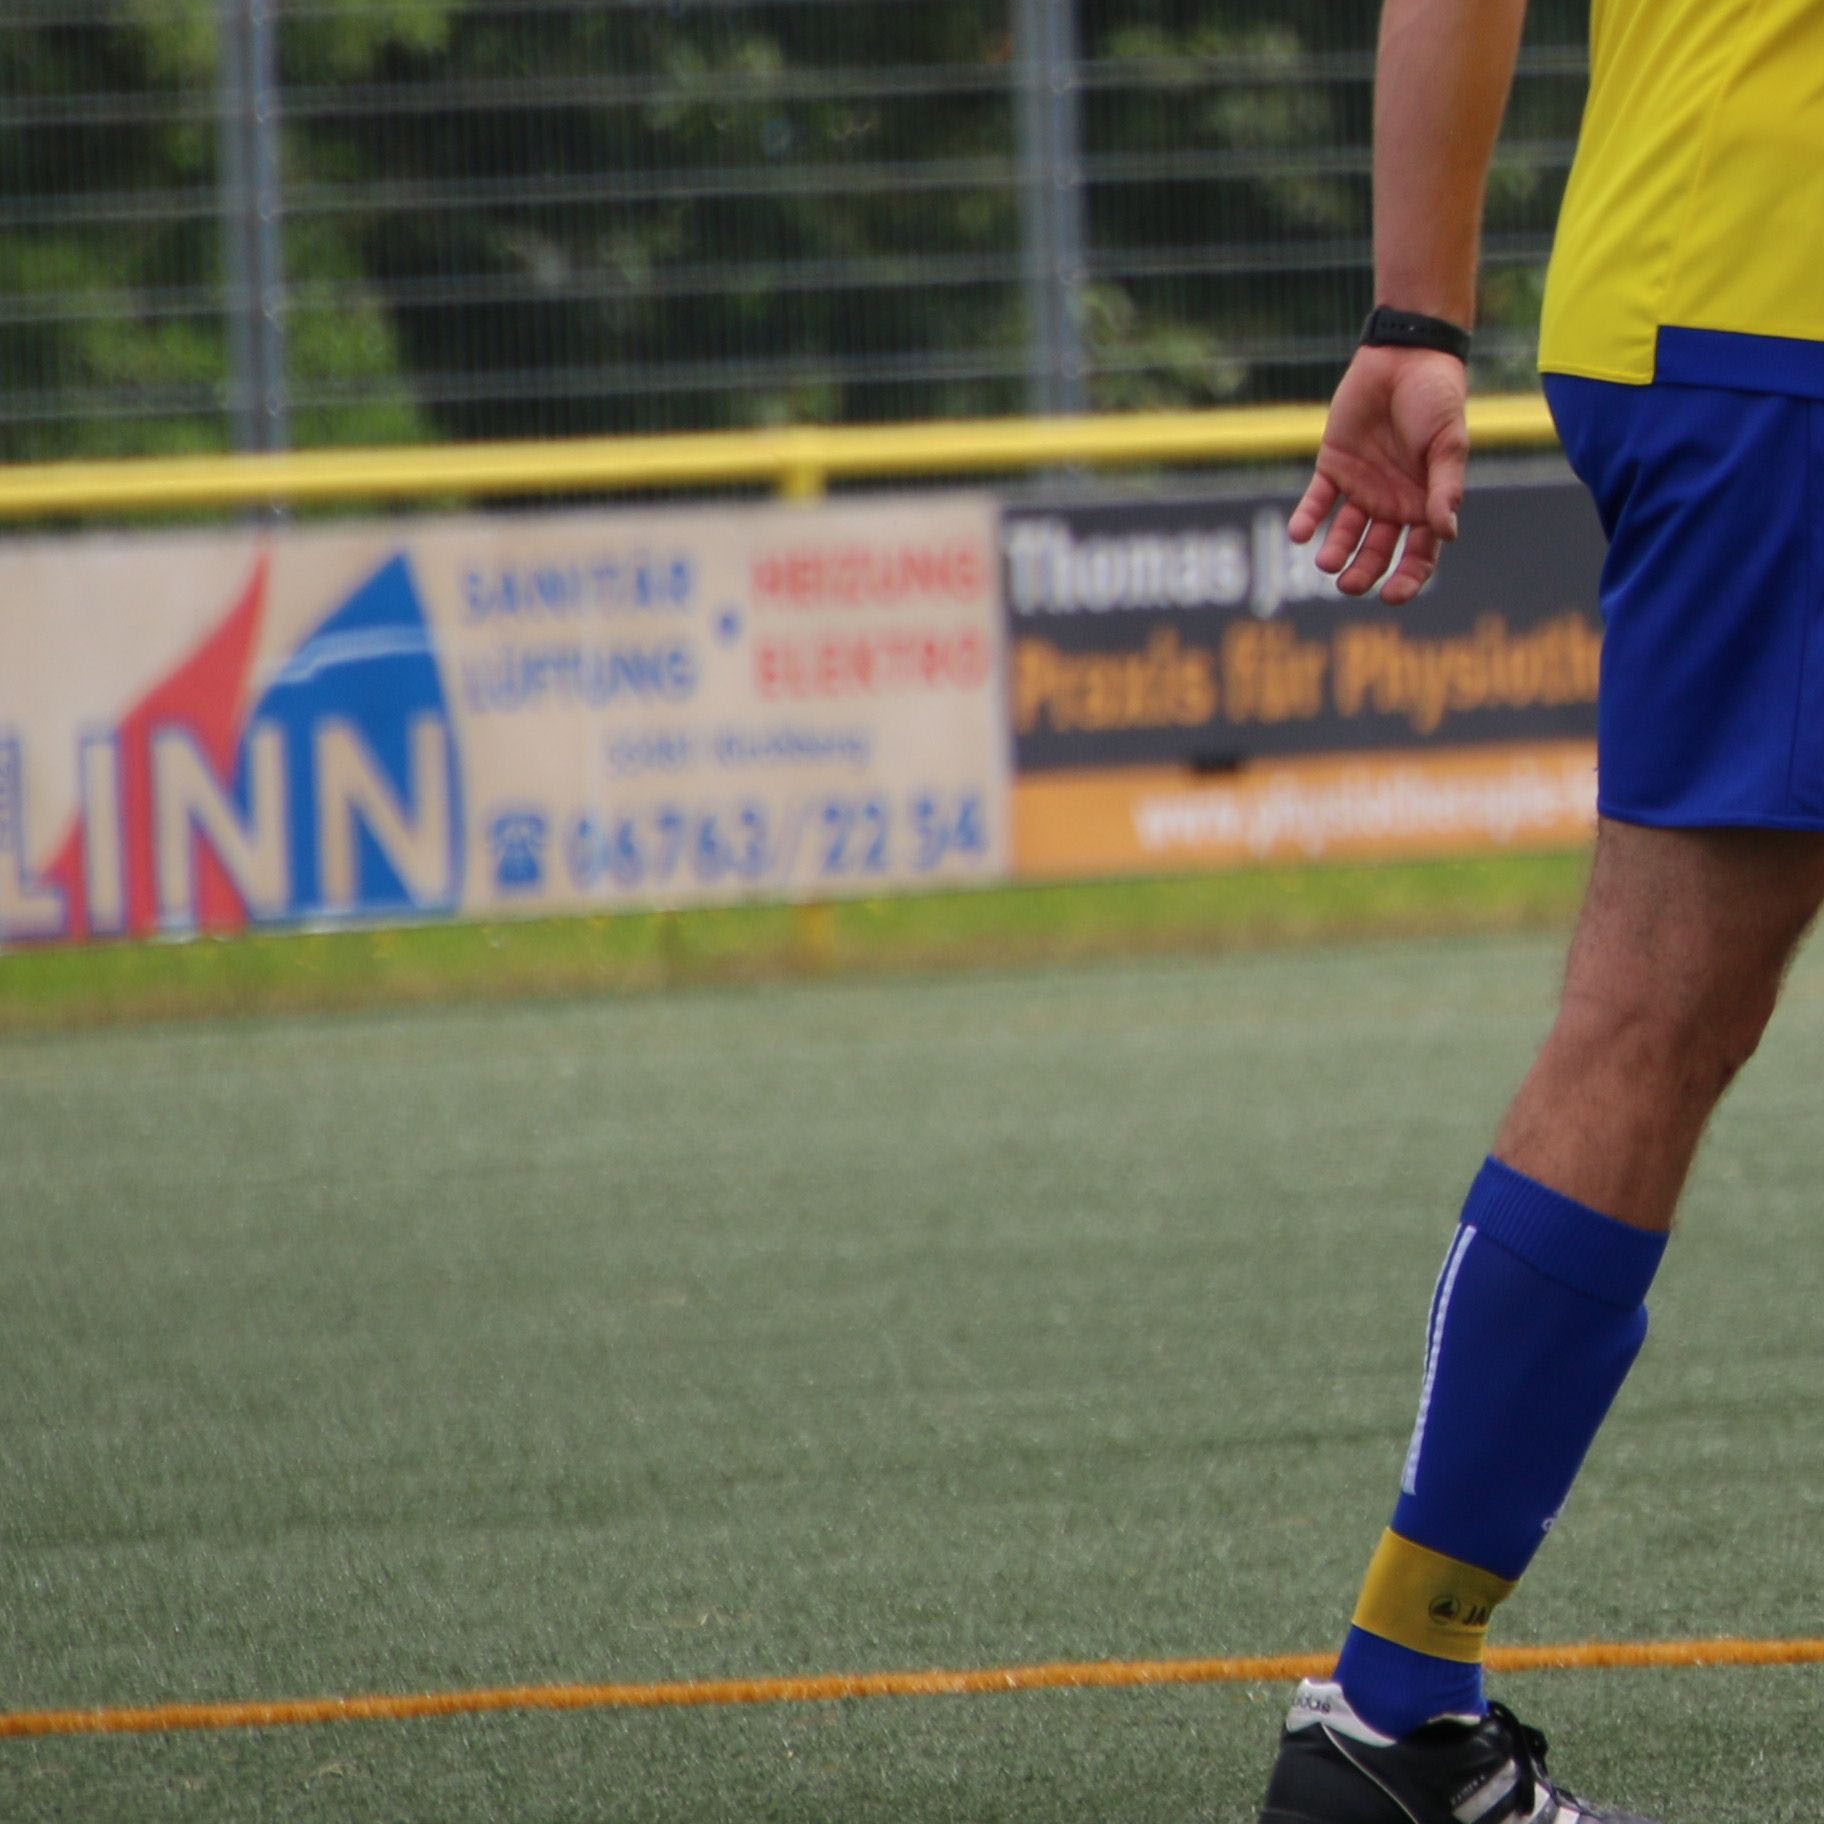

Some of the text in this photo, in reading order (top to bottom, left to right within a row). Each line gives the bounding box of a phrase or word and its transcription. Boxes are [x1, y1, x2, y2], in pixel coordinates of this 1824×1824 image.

[1004, 514, 1248, 616] Thomas
[1013, 610, 1600, 736] Praxis für Physioth
